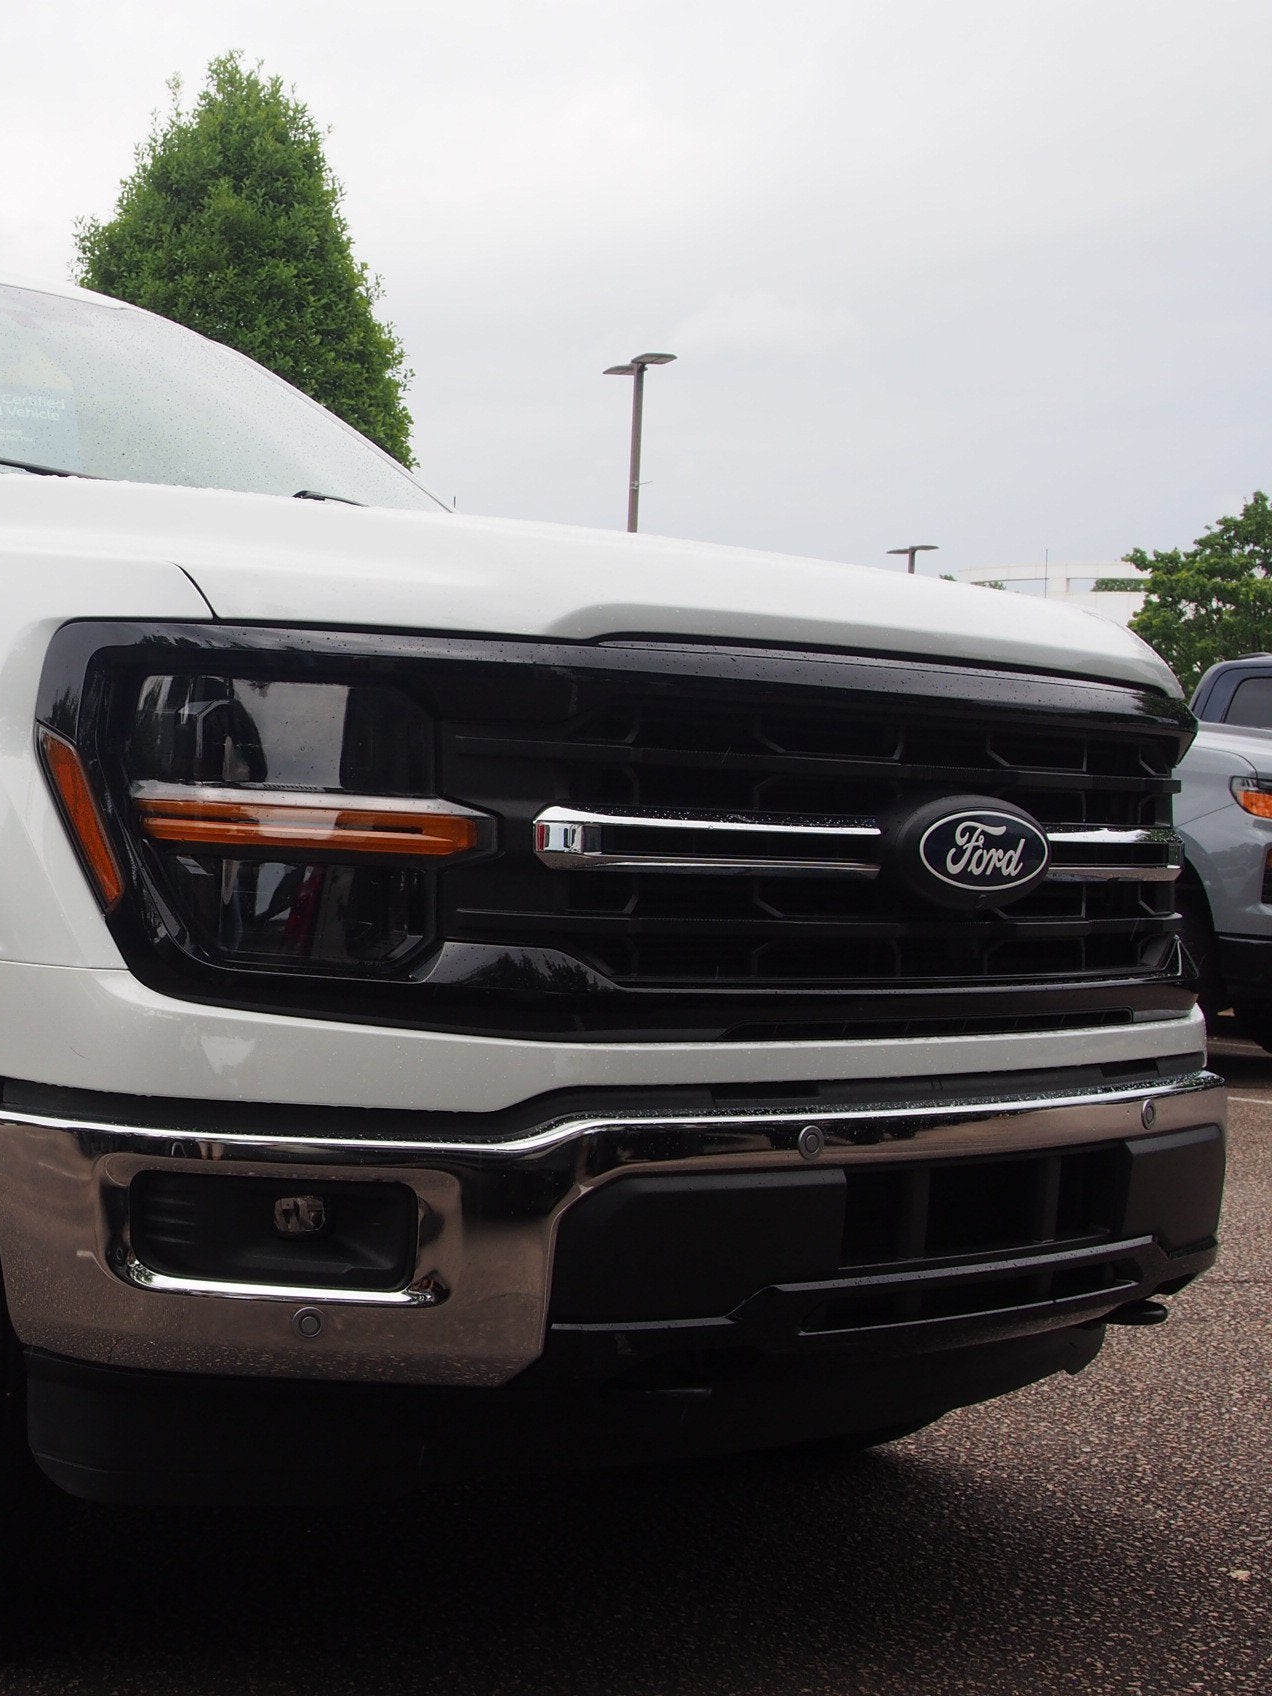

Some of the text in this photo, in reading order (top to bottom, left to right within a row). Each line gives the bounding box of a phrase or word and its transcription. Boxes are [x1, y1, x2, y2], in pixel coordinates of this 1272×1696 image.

[1, 393, 66, 410] Certified
[7, 406, 60, 421] Vehicle
[945, 820, 1026, 877] Ford
